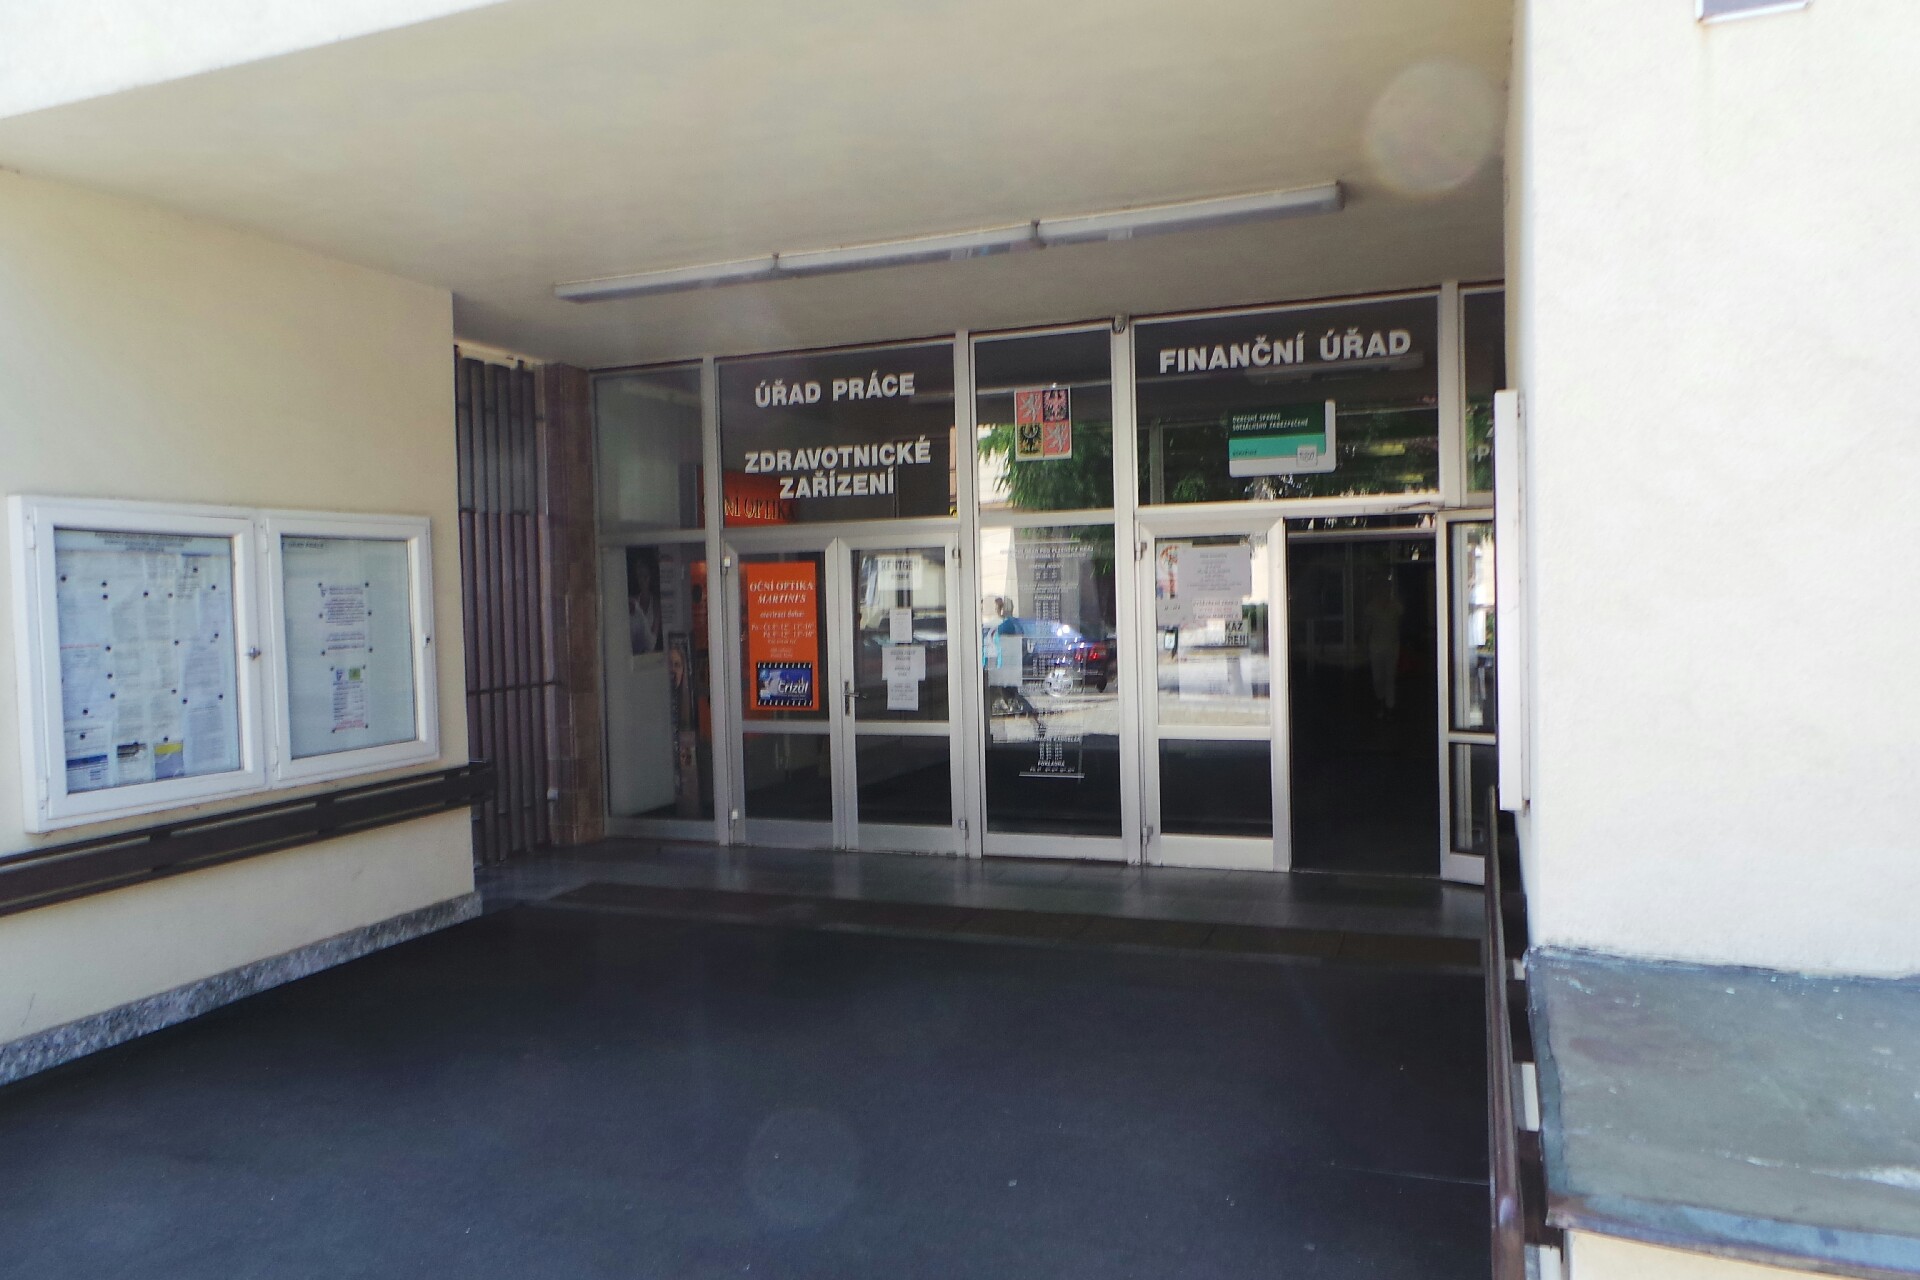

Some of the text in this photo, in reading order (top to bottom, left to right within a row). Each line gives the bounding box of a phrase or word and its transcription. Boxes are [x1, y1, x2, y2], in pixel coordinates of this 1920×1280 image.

[1159, 327, 1412, 374] FINANČNÍ ÚŘAD
[754, 369, 915, 408] ÚŘAD PRÁCE
[744, 435, 931, 474] ZDRAVOTNICKÉ
[779, 466, 894, 499] ZAŘÍZENÍ
[776, 580, 814, 592] OPTIKA
